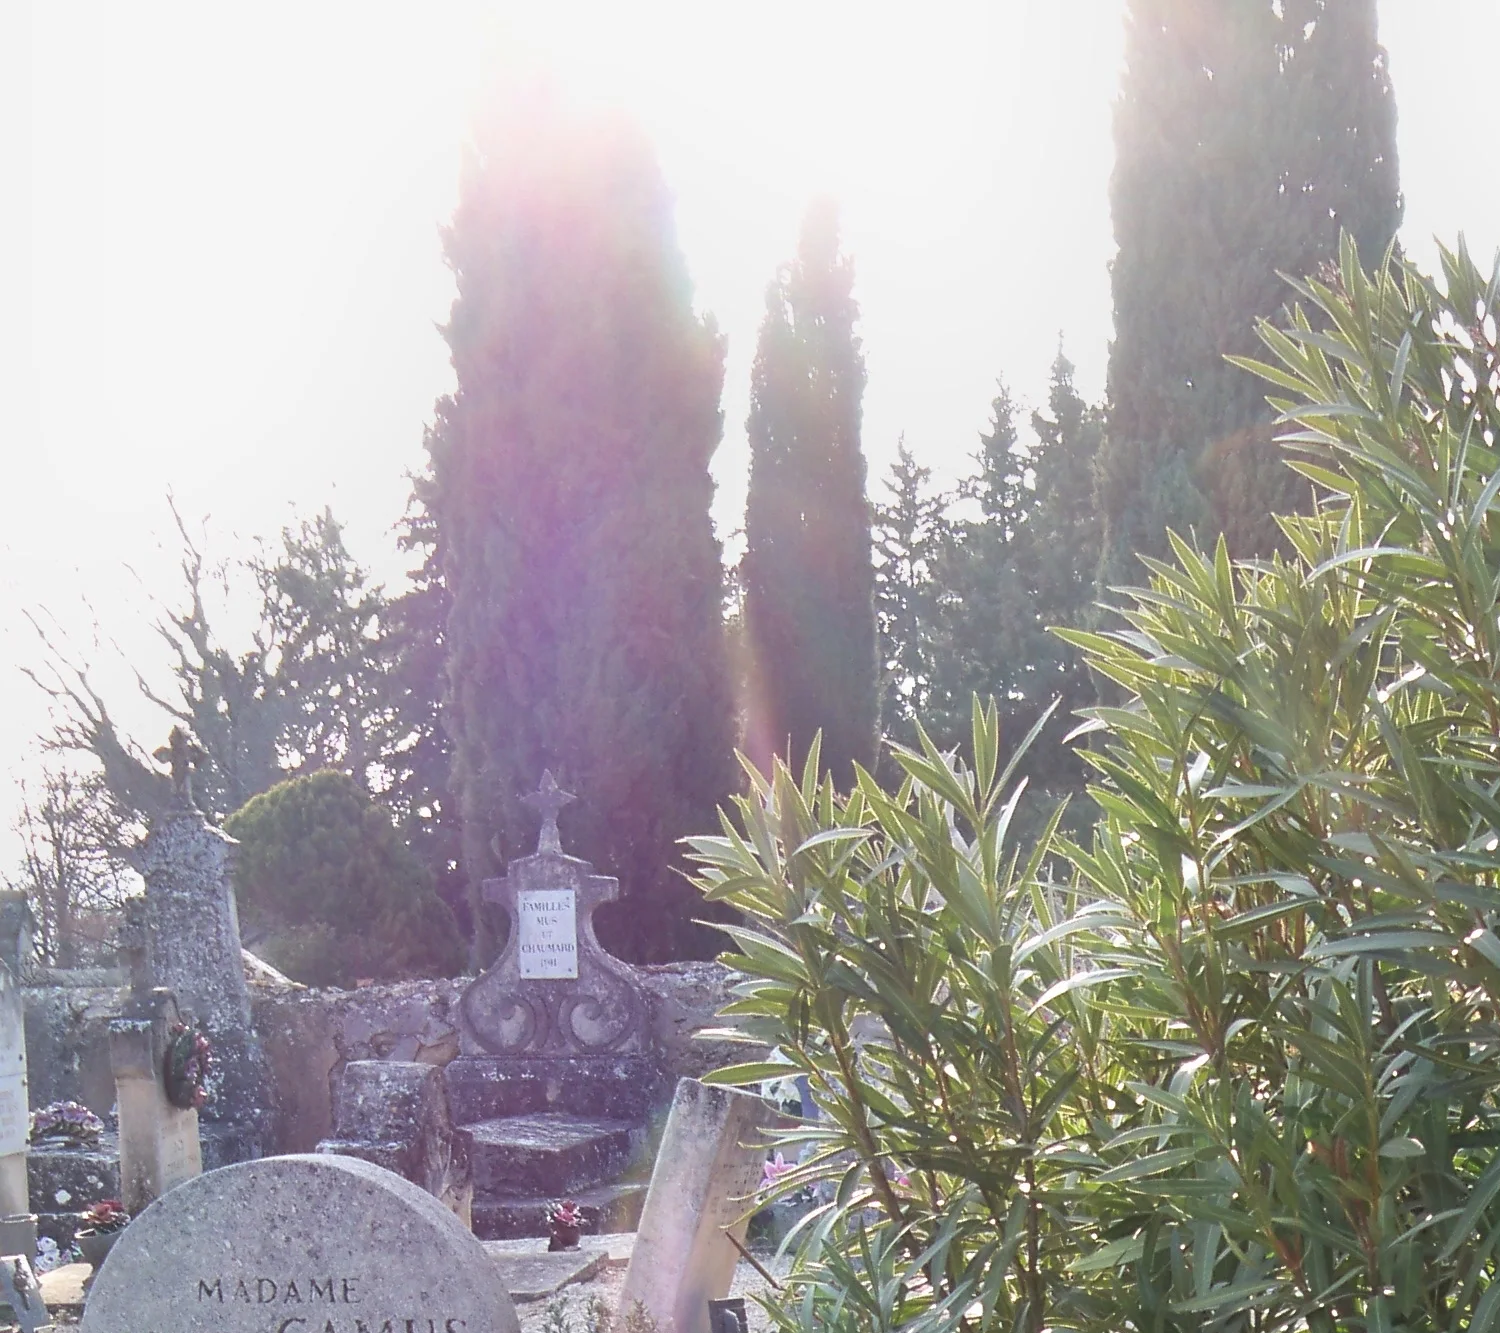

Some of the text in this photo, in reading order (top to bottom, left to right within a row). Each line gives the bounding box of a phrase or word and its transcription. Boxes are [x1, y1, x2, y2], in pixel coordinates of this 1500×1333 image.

[522, 901, 571, 912] FAMILLES
[536, 915, 558, 926] MUS
[521, 943, 575, 954] CHAUMARD
[198, 1276, 363, 1305] MADAME
